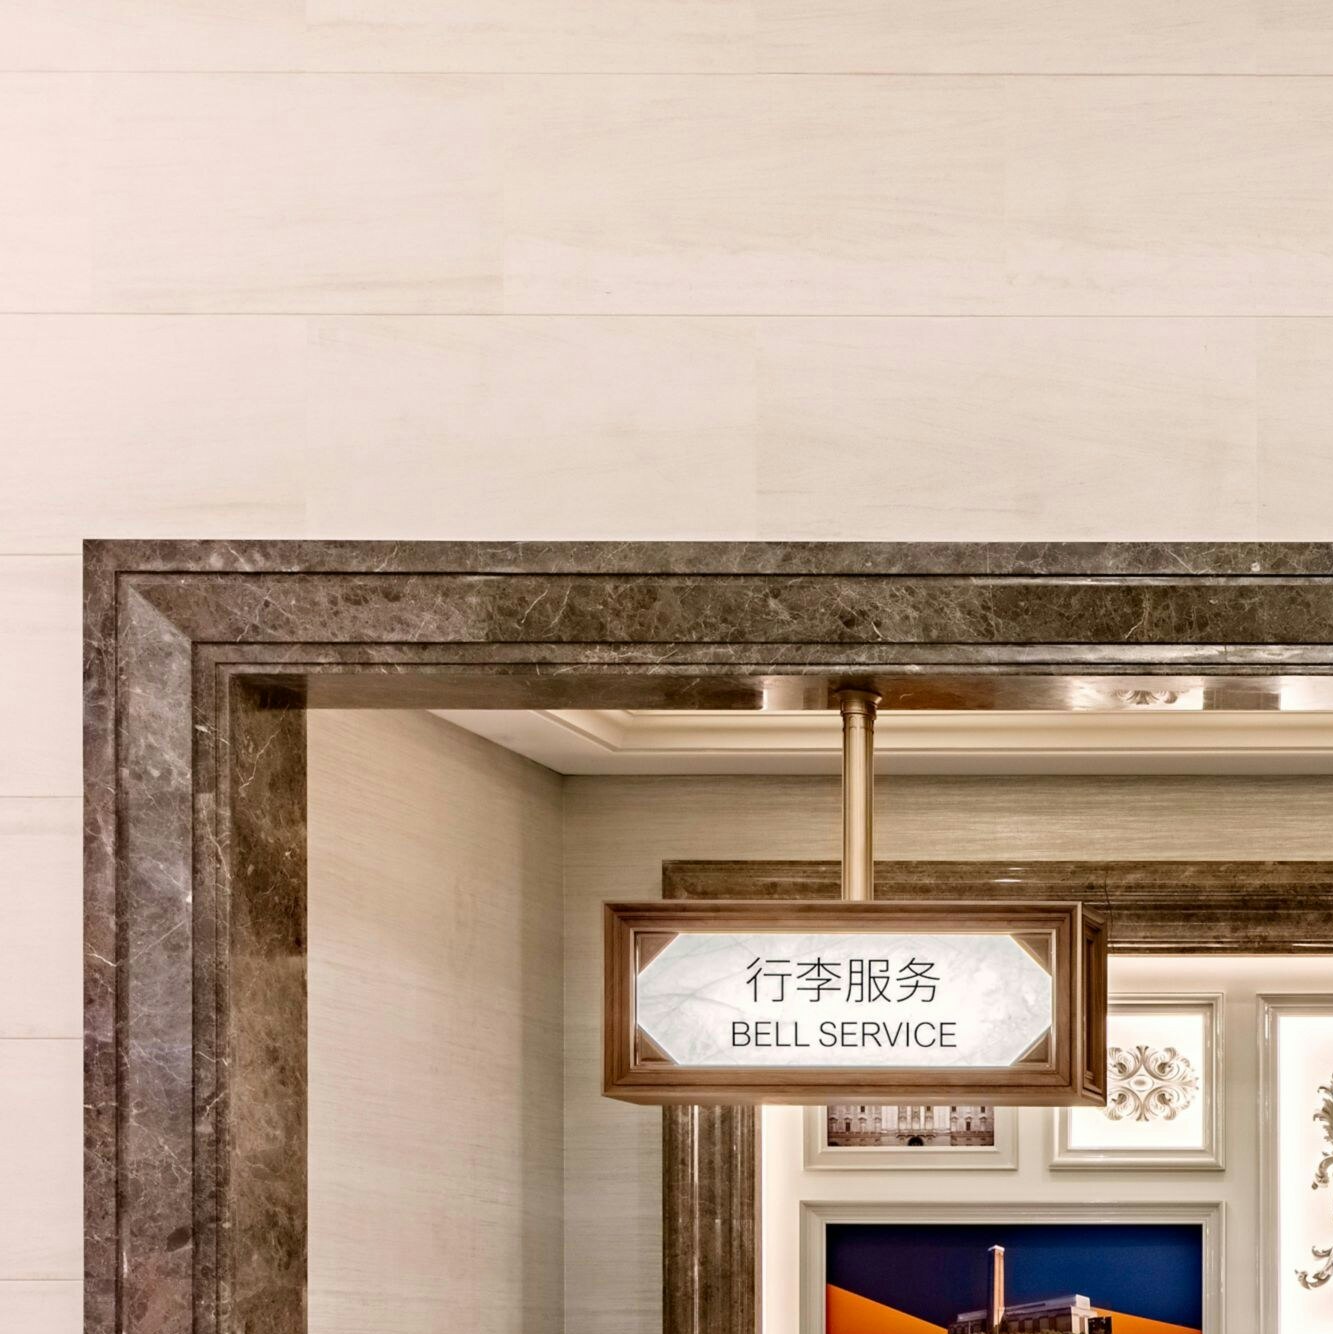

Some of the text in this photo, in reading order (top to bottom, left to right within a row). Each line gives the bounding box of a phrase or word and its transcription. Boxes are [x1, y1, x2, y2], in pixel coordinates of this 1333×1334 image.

[746, 957, 940, 1003] 行李服务
[732, 1021, 957, 1048] BELL SERVICE
